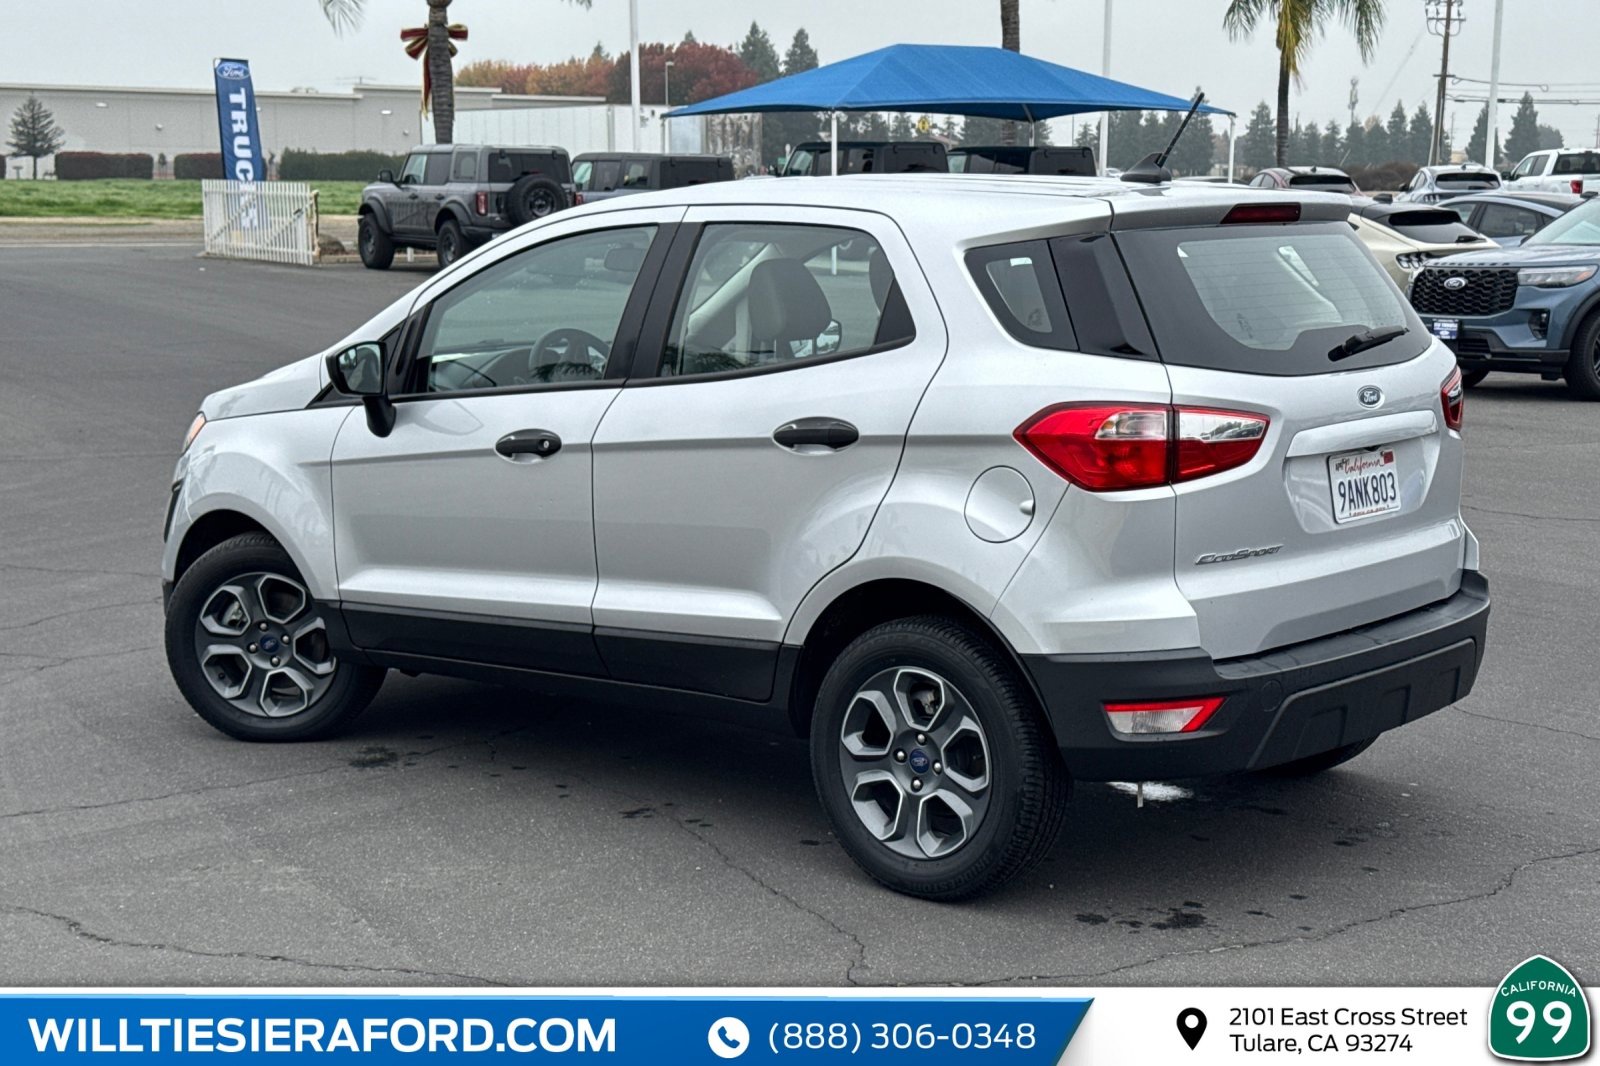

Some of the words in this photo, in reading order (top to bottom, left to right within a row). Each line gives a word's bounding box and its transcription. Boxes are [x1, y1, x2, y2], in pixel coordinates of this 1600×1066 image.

[220, 64, 246, 78] Ford
[1344, 456, 1385, 475] California
[1337, 471, 1397, 513] 9ANK803
